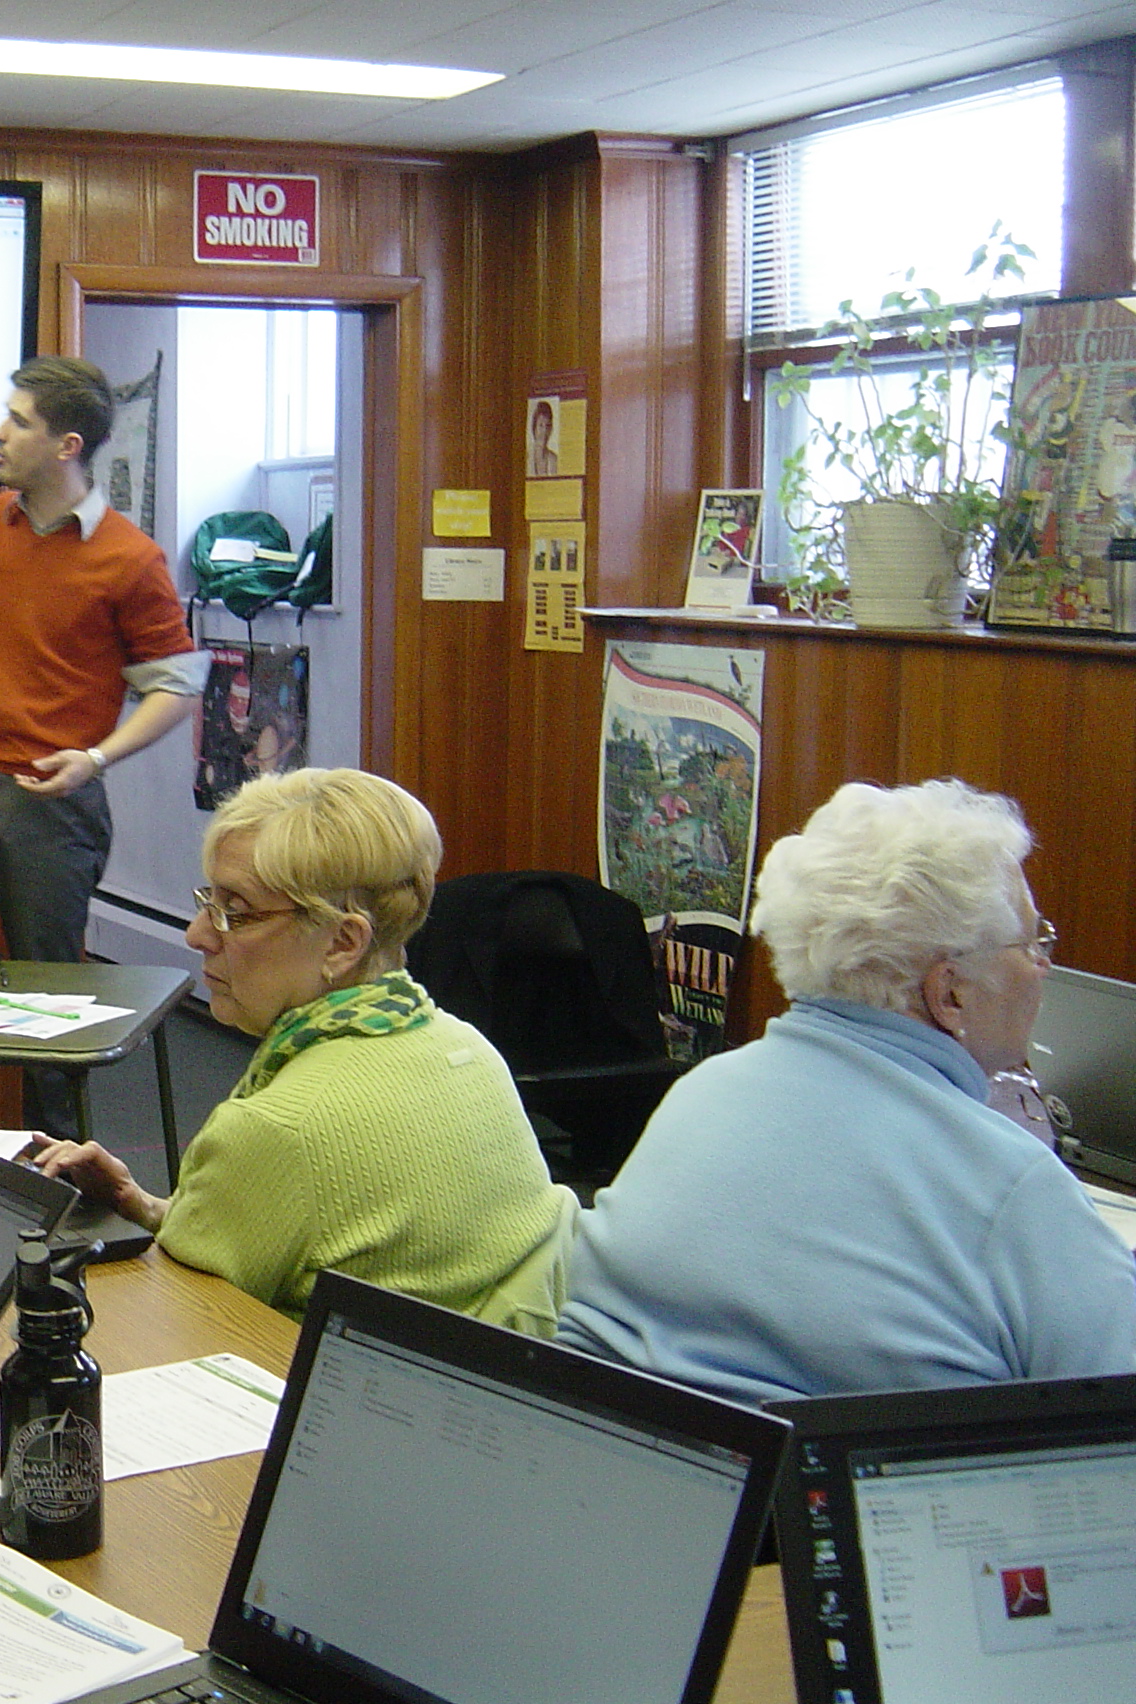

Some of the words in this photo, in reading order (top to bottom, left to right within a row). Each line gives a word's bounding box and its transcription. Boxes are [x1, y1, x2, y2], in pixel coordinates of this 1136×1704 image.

[227, 182, 286, 216] NO
[205, 215, 309, 248] SMOKING
[14, 1421, 45, 1454] CORPS
